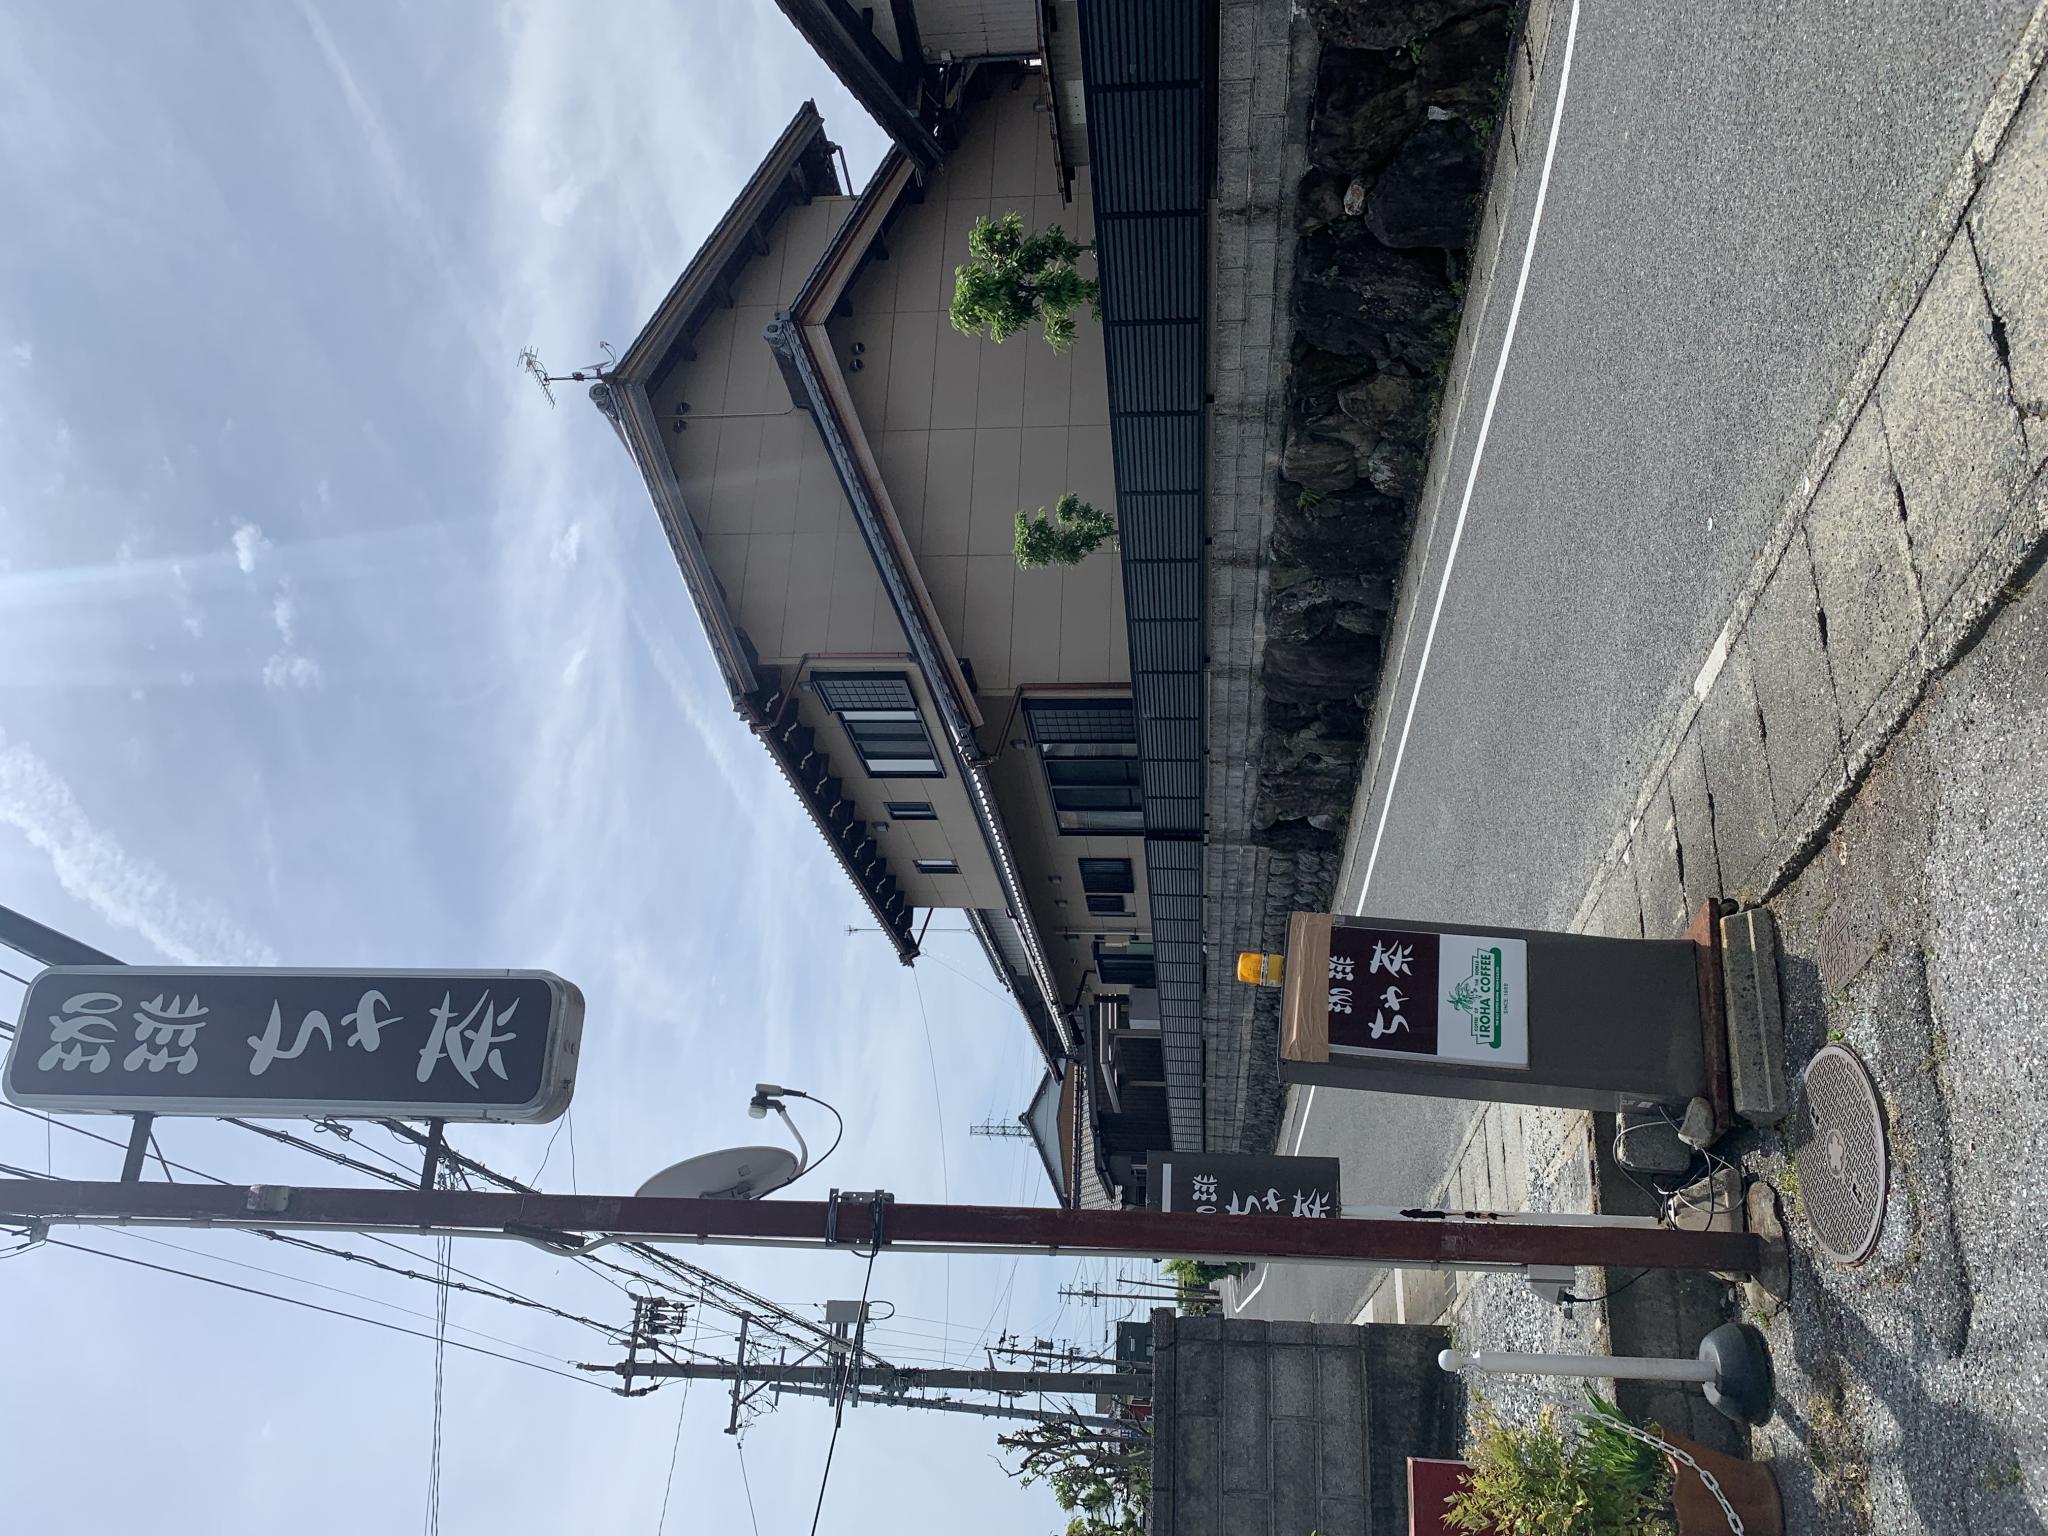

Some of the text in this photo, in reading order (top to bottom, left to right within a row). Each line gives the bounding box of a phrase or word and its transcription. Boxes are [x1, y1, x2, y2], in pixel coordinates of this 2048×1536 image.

[1368, 940, 1414, 1039] ちゃ茶
[1480, 955, 1491, 1038] IROHA COFFEE
[37, 989, 520, 1088] 珈琲 ちゃ茶
[1192, 1174, 1218, 1214] 琲
